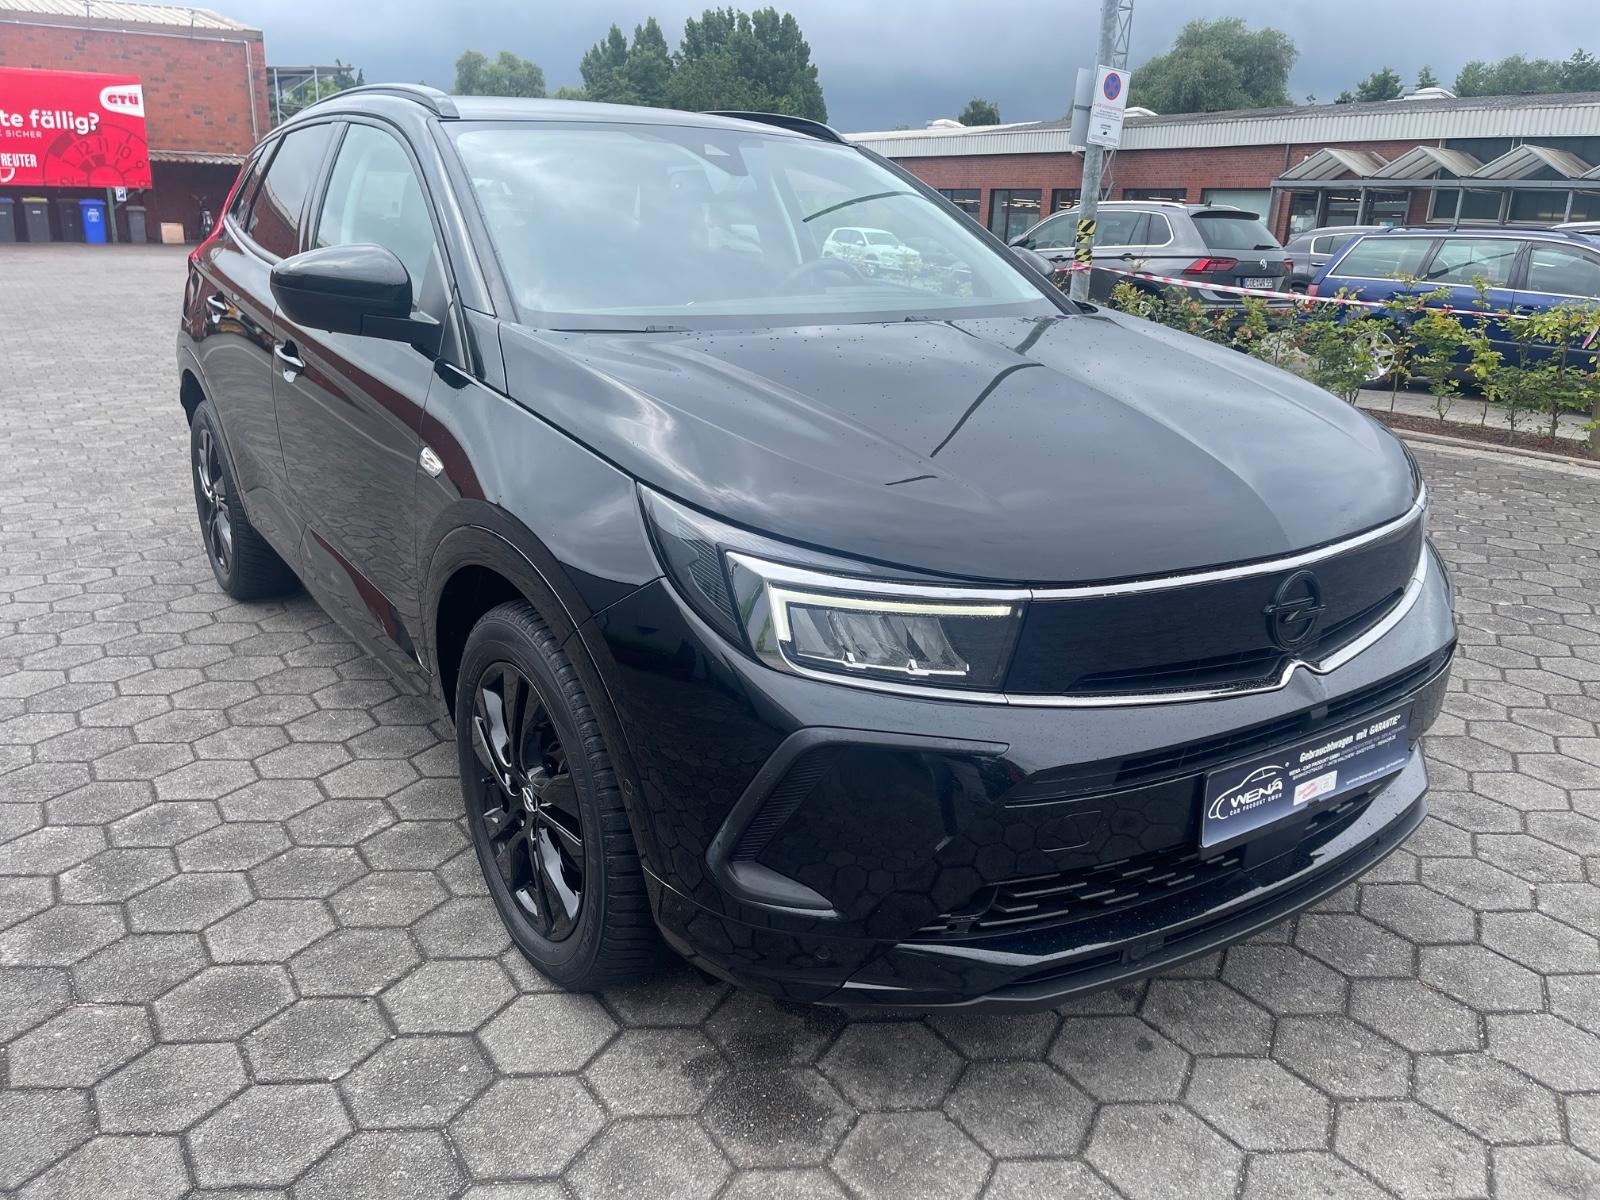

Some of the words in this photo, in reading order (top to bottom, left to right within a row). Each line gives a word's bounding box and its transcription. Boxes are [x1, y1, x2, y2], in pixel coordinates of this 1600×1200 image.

[107, 93, 139, 105] GTÜ
[29, 109, 100, 135] fällig?
[5, 130, 42, 139] SICHER
[1, 153, 37, 168] REUTER
[1299, 735, 1354, 763] Gebrauchtwagen
[1356, 728, 1368, 741] mit
[1242, 798, 1266, 811] PRODUKT
